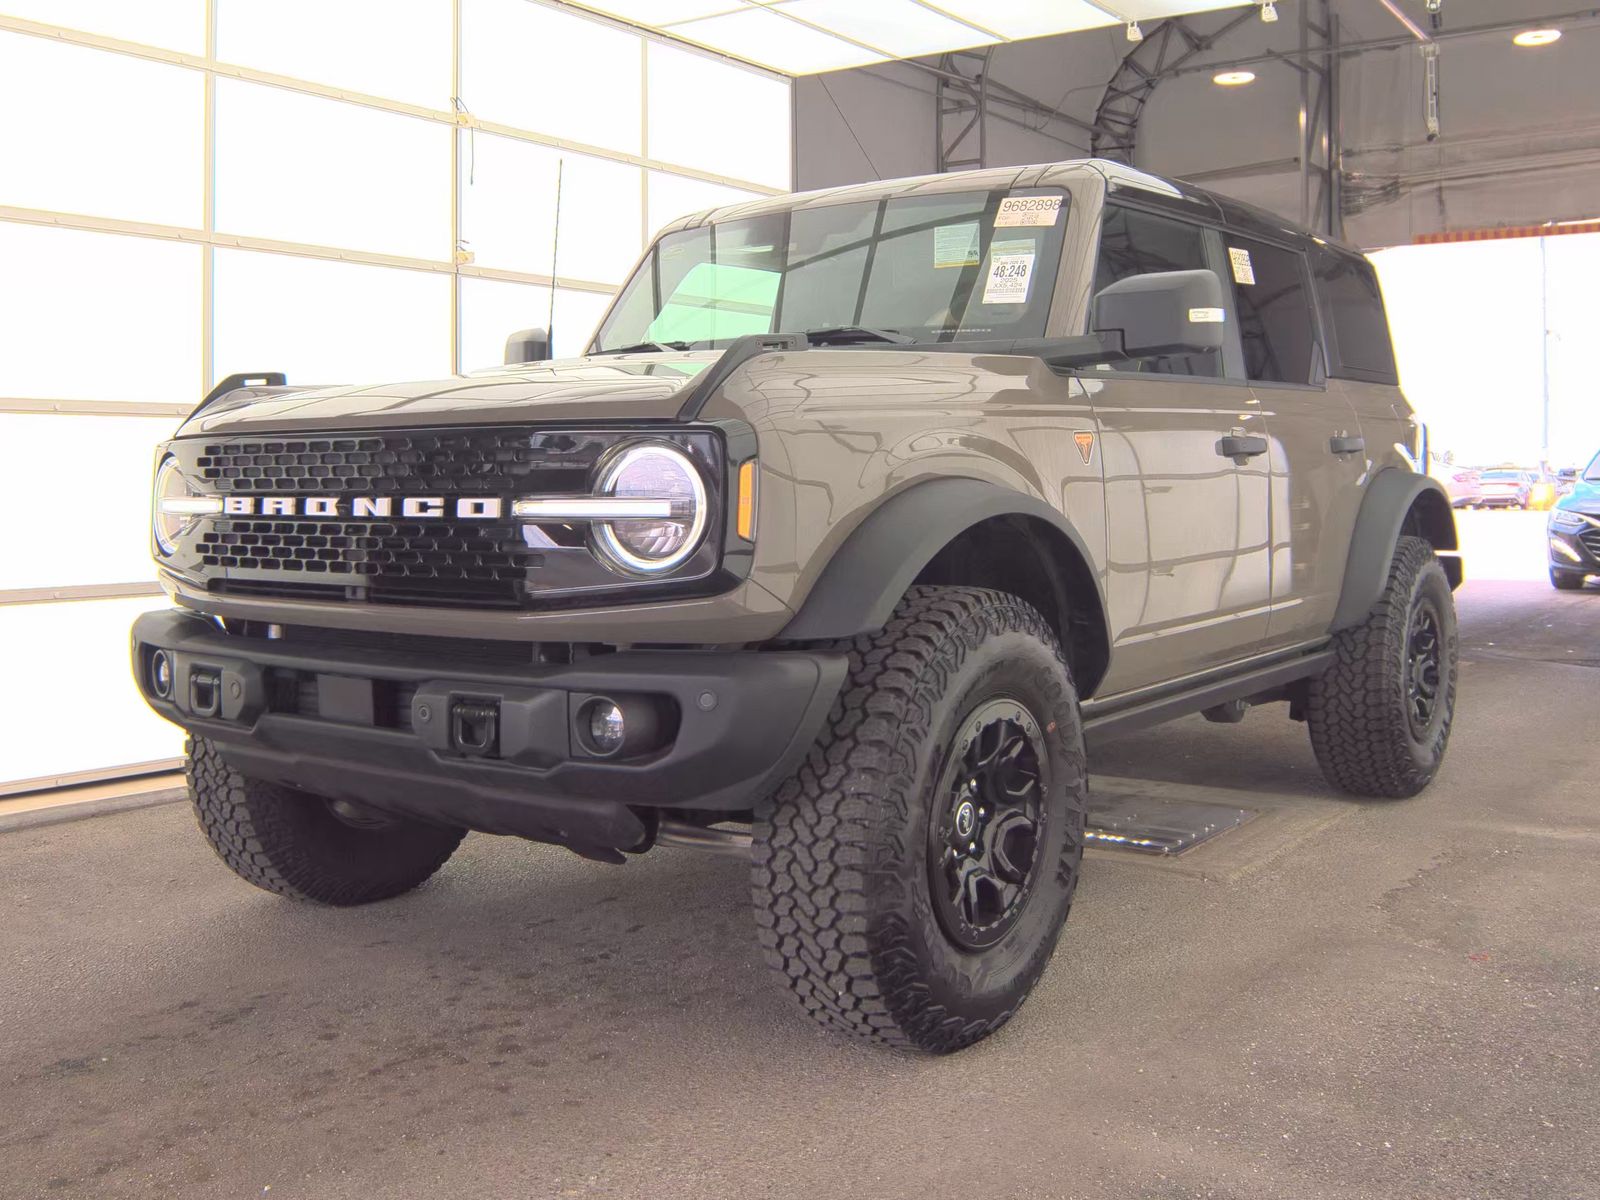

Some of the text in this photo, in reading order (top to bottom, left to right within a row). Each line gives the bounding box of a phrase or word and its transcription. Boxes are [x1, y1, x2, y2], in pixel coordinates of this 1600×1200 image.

[1002, 198, 1062, 212] 9682898
[993, 265, 1027, 278] 48:248
[223, 496, 501, 519] BRONCO
